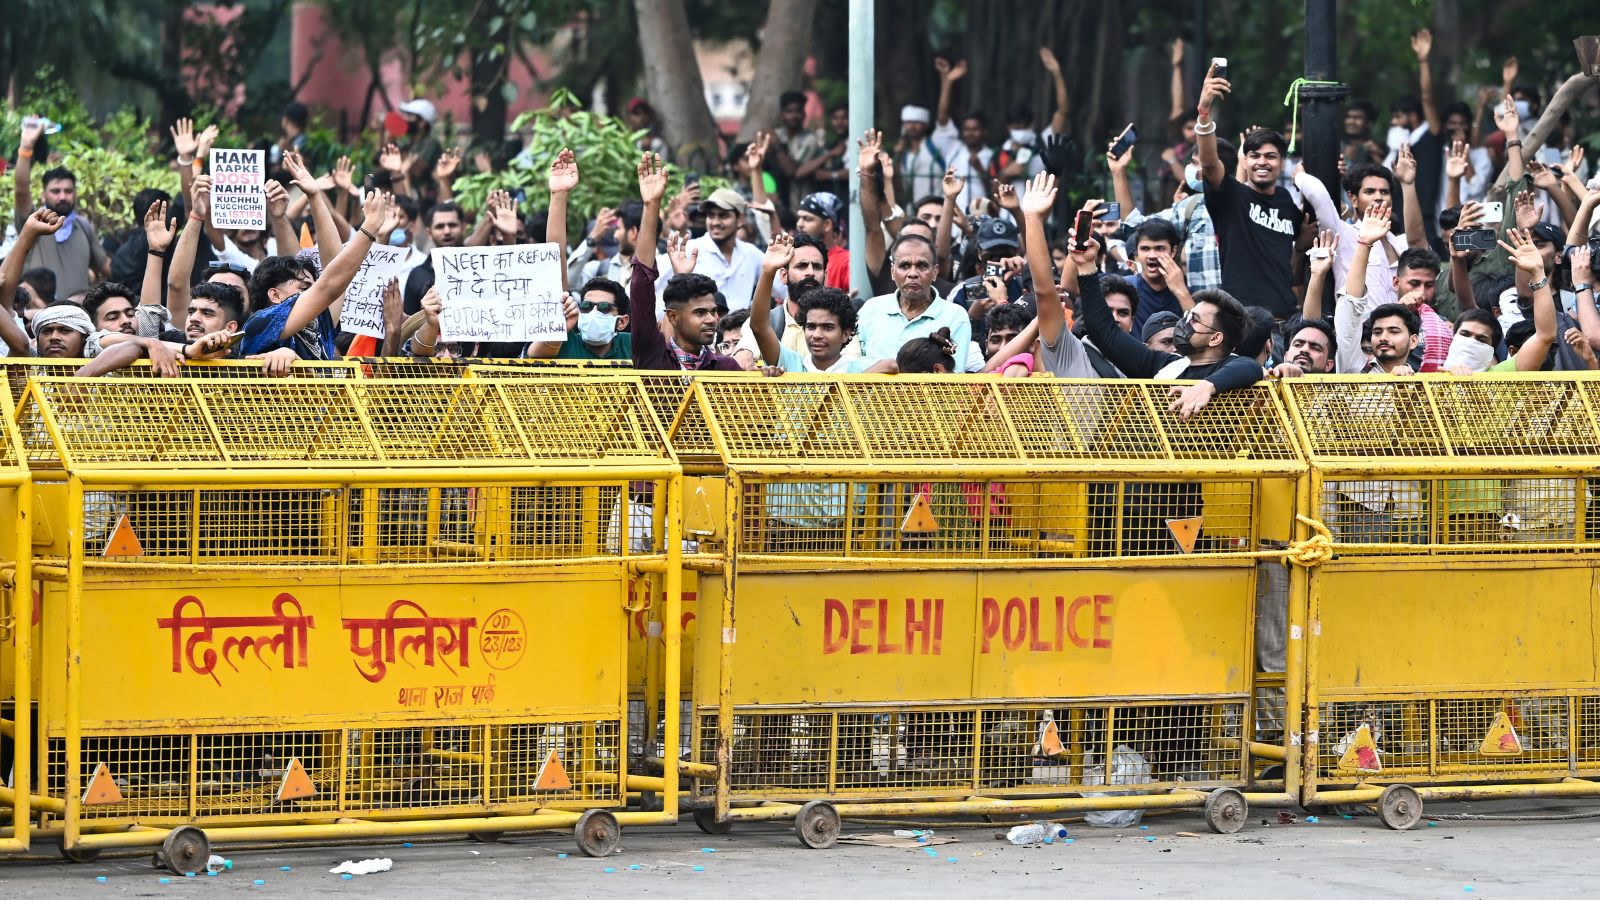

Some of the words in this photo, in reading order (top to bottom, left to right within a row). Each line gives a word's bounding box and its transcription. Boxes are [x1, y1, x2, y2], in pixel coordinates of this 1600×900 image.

[215, 152, 257, 164] HAM
[215, 164, 259, 173] AAPKE
[215, 173, 260, 184] DOST
[215, 185, 246, 193] NAHI
[250, 185, 263, 194] H.
[215, 203, 263, 211] PUCCHCHHI
[216, 196, 259, 204] KUCHHU
[229, 211, 263, 219] ISTIFA
[368, 250, 399, 264] NTAR
[442, 252, 489, 273] NEET
[493, 252, 514, 270] का
[518, 250, 560, 264] REFUND
[447, 275, 469, 300] तो
[471, 271, 490, 298] दे
[492, 272, 533, 301] दिया
[442, 306, 498, 327] FUTURE
[505, 304, 526, 320] का
[492, 615, 511, 629] OD
[823, 598, 944, 655] DELHI
[981, 595, 1114, 654] POLICE
[157, 593, 316, 687] दिल्ली
[342, 599, 478, 684] पुलिस
[398, 687, 428, 707] थाना
[434, 686, 466, 708] राज
[471, 672, 496, 704] पार्क
